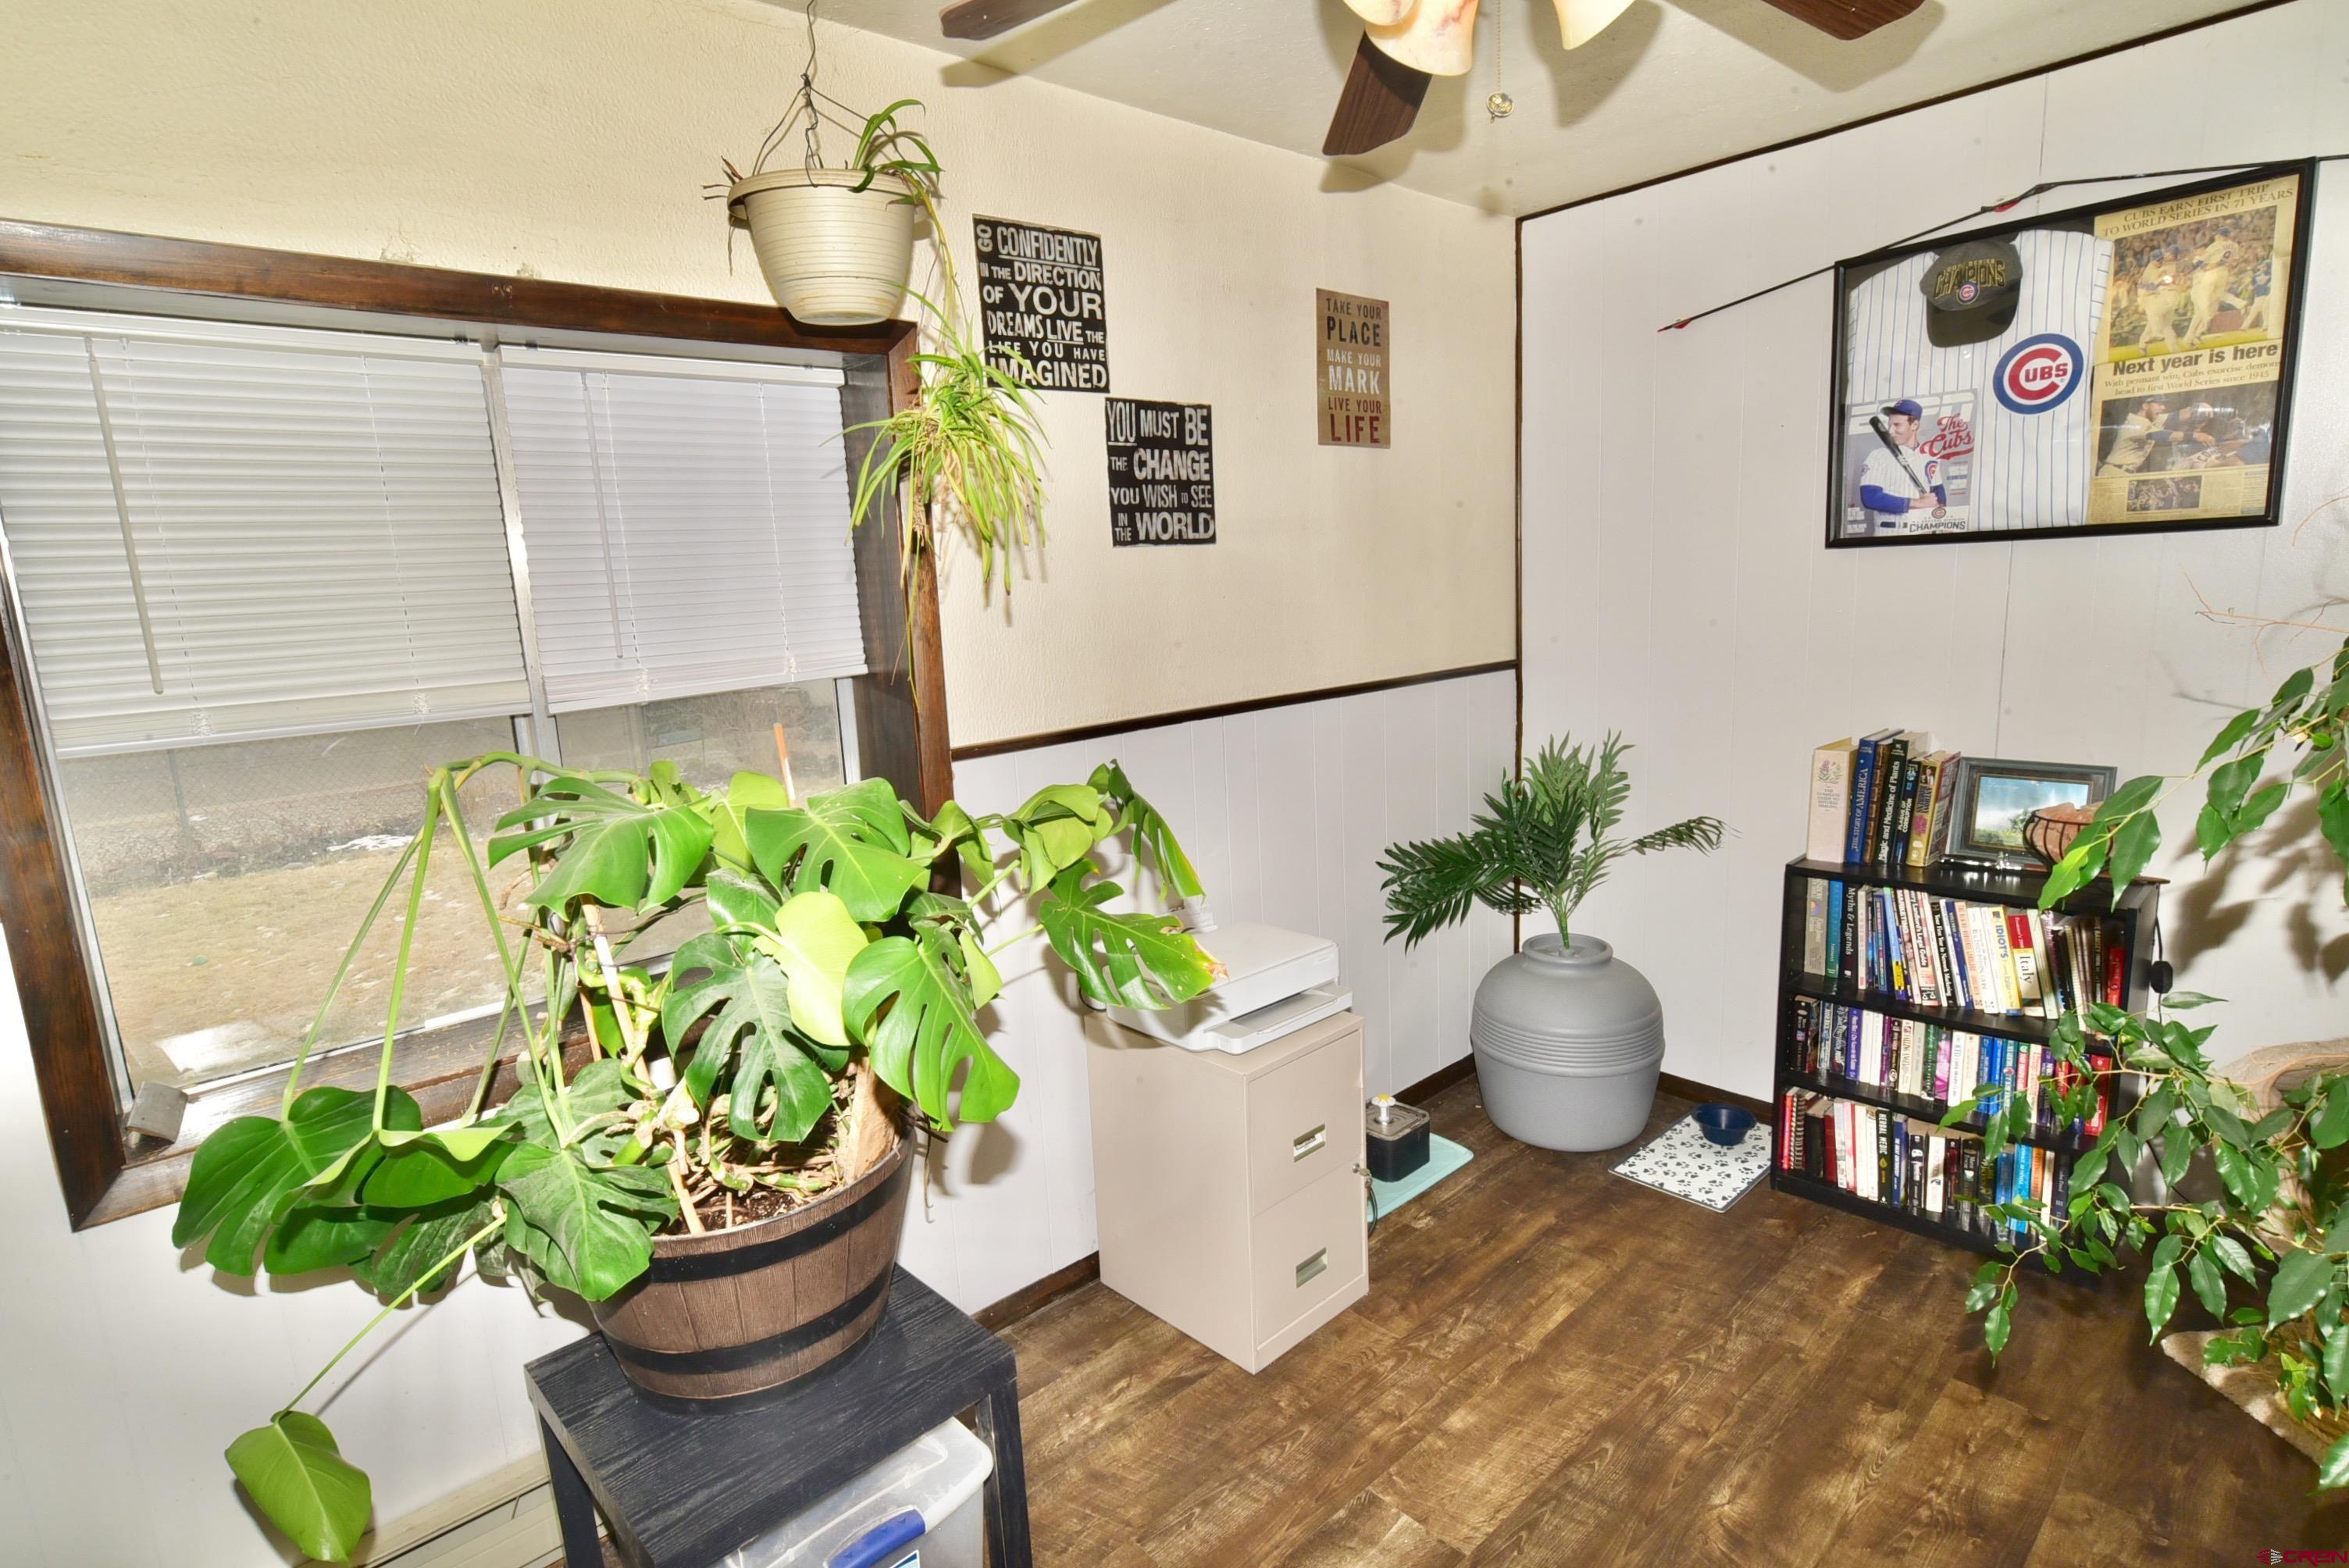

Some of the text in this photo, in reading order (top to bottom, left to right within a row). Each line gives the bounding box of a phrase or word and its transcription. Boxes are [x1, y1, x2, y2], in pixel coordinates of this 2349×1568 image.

[2103, 188, 2294, 237] TO WORLD SERIES IN 71 YEARS
[2124, 184, 2269, 223] CUBS EARN FIRST TRIP
[976, 224, 993, 252] GO
[996, 226, 1098, 266] CONFIDENTLY
[991, 266, 1011, 280] THE
[1014, 261, 1102, 291] DIRECTION
[982, 283, 1103, 320] OF YOUR
[1326, 298, 1381, 321] TAKE YOUR
[986, 310, 1104, 344] DREAMS LIVE THE
[1327, 315, 1381, 347] PLACE
[989, 340, 1105, 362] LIFE YOU HAVE
[1327, 348, 1381, 367] MAKE YOUR
[2112, 344, 2278, 376] Next year is here
[989, 357, 1107, 389] IMAGINED
[1328, 365, 1380, 394] MARK
[2009, 347, 2068, 401] CUBS
[2105, 380, 2124, 388] With
[2126, 376, 2160, 387] pennant
[2183, 369, 2205, 379] Cubs
[2207, 365, 2244, 376] exorcise
[2167, 380, 2192, 390] World
[2194, 377, 2220, 387] Series
[2223, 375, 2246, 383] since
[1328, 397, 1381, 414] LIVE YOUR
[1107, 401, 1208, 447] YOU MUST BE
[1330, 413, 1381, 444] LIFE
[1937, 412, 1968, 432] The
[1919, 429, 1974, 458] Cubs
[1110, 447, 1210, 481] THE CHANGE
[1110, 485, 1213, 508] YOU WISH TO SEE
[1114, 512, 1214, 542] THE WORLD
[1118, 512, 1128, 527] IN
[1909, 521, 1966, 533] CHAMPIONS
[1889, 761, 1900, 783] Plants
[1856, 768, 1868, 809] AMERICA
[1888, 784, 1896, 793] of
[1855, 808, 1862, 817] OF
[1883, 793, 1895, 825] Medicine
[1902, 798, 1912, 833] CORRUPTION
[1878, 841, 1889, 861] Magic
[1847, 887, 1856, 912] Myths
[1896, 889, 1909, 934] MARKETING
[1912, 903, 1923, 932] Landlord's
[1845, 923, 1854, 955] Legends
[1916, 932, 1925, 949] Legal
[1995, 925, 2009, 958] IDIOT'S
[1919, 949, 1927, 967] Guide
[1941, 953, 1949, 973] Network
[2019, 956, 2034, 985] Italy
[1944, 973, 1952, 996] Marketing
[1878, 1113, 1887, 1155] HERBAL MEDIC
